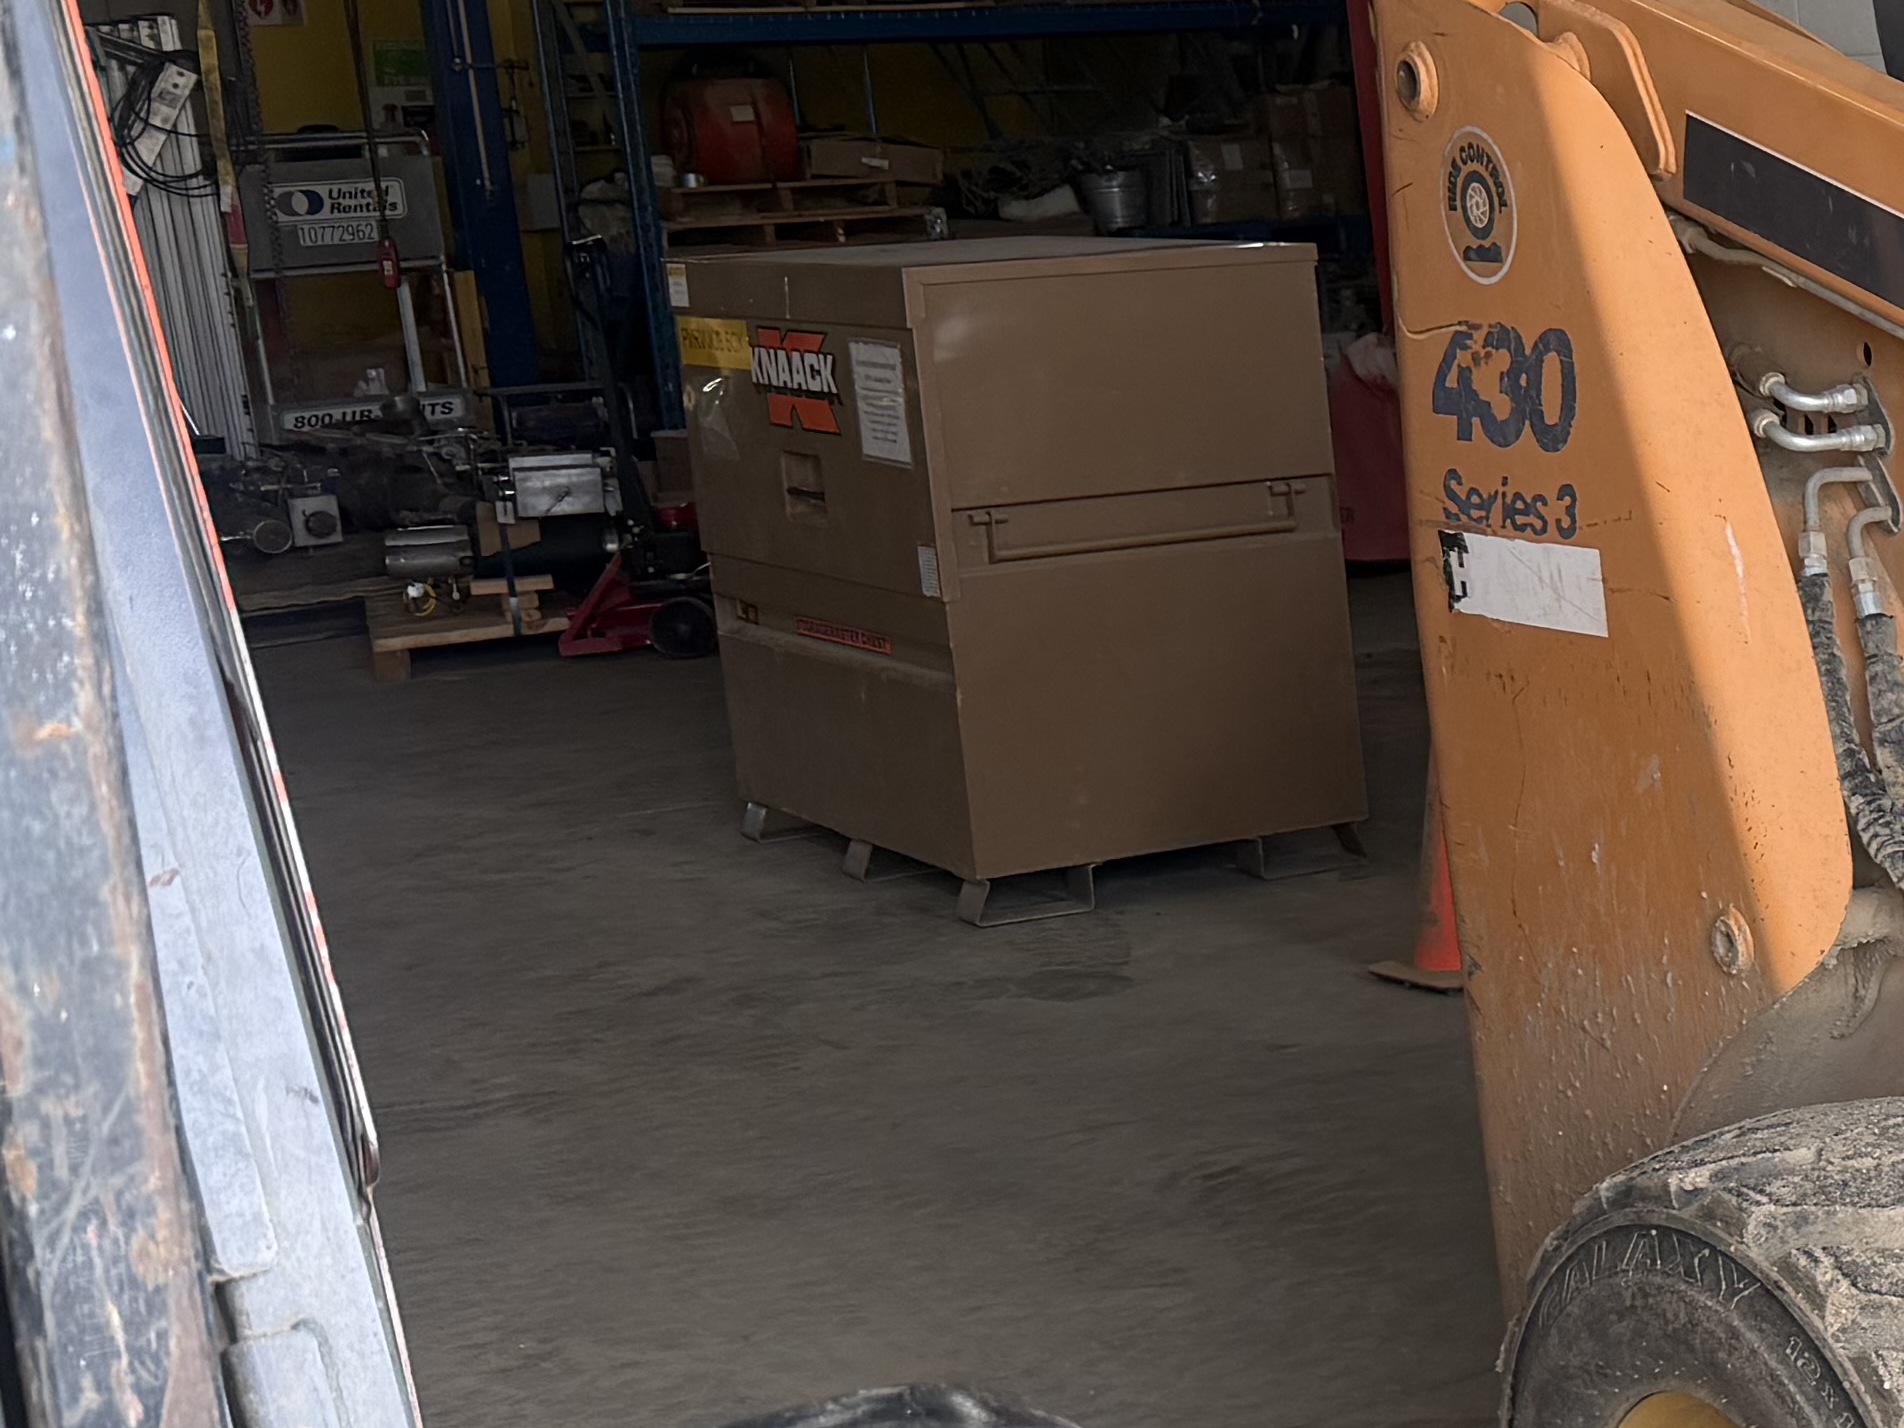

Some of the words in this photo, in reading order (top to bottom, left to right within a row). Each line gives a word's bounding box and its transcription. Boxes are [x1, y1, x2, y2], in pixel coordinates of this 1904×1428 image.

[1447, 156, 1462, 212] RIDE
[1459, 140, 1509, 214] CONTROL
[300, 222, 375, 245] 10772962
[751, 346, 839, 394] KNAACK
[1432, 321, 1577, 453] 430
[1442, 468, 1550, 537] Series
[1555, 483, 1579, 539] 3
[1538, 1230, 1763, 1332] GALAXY
